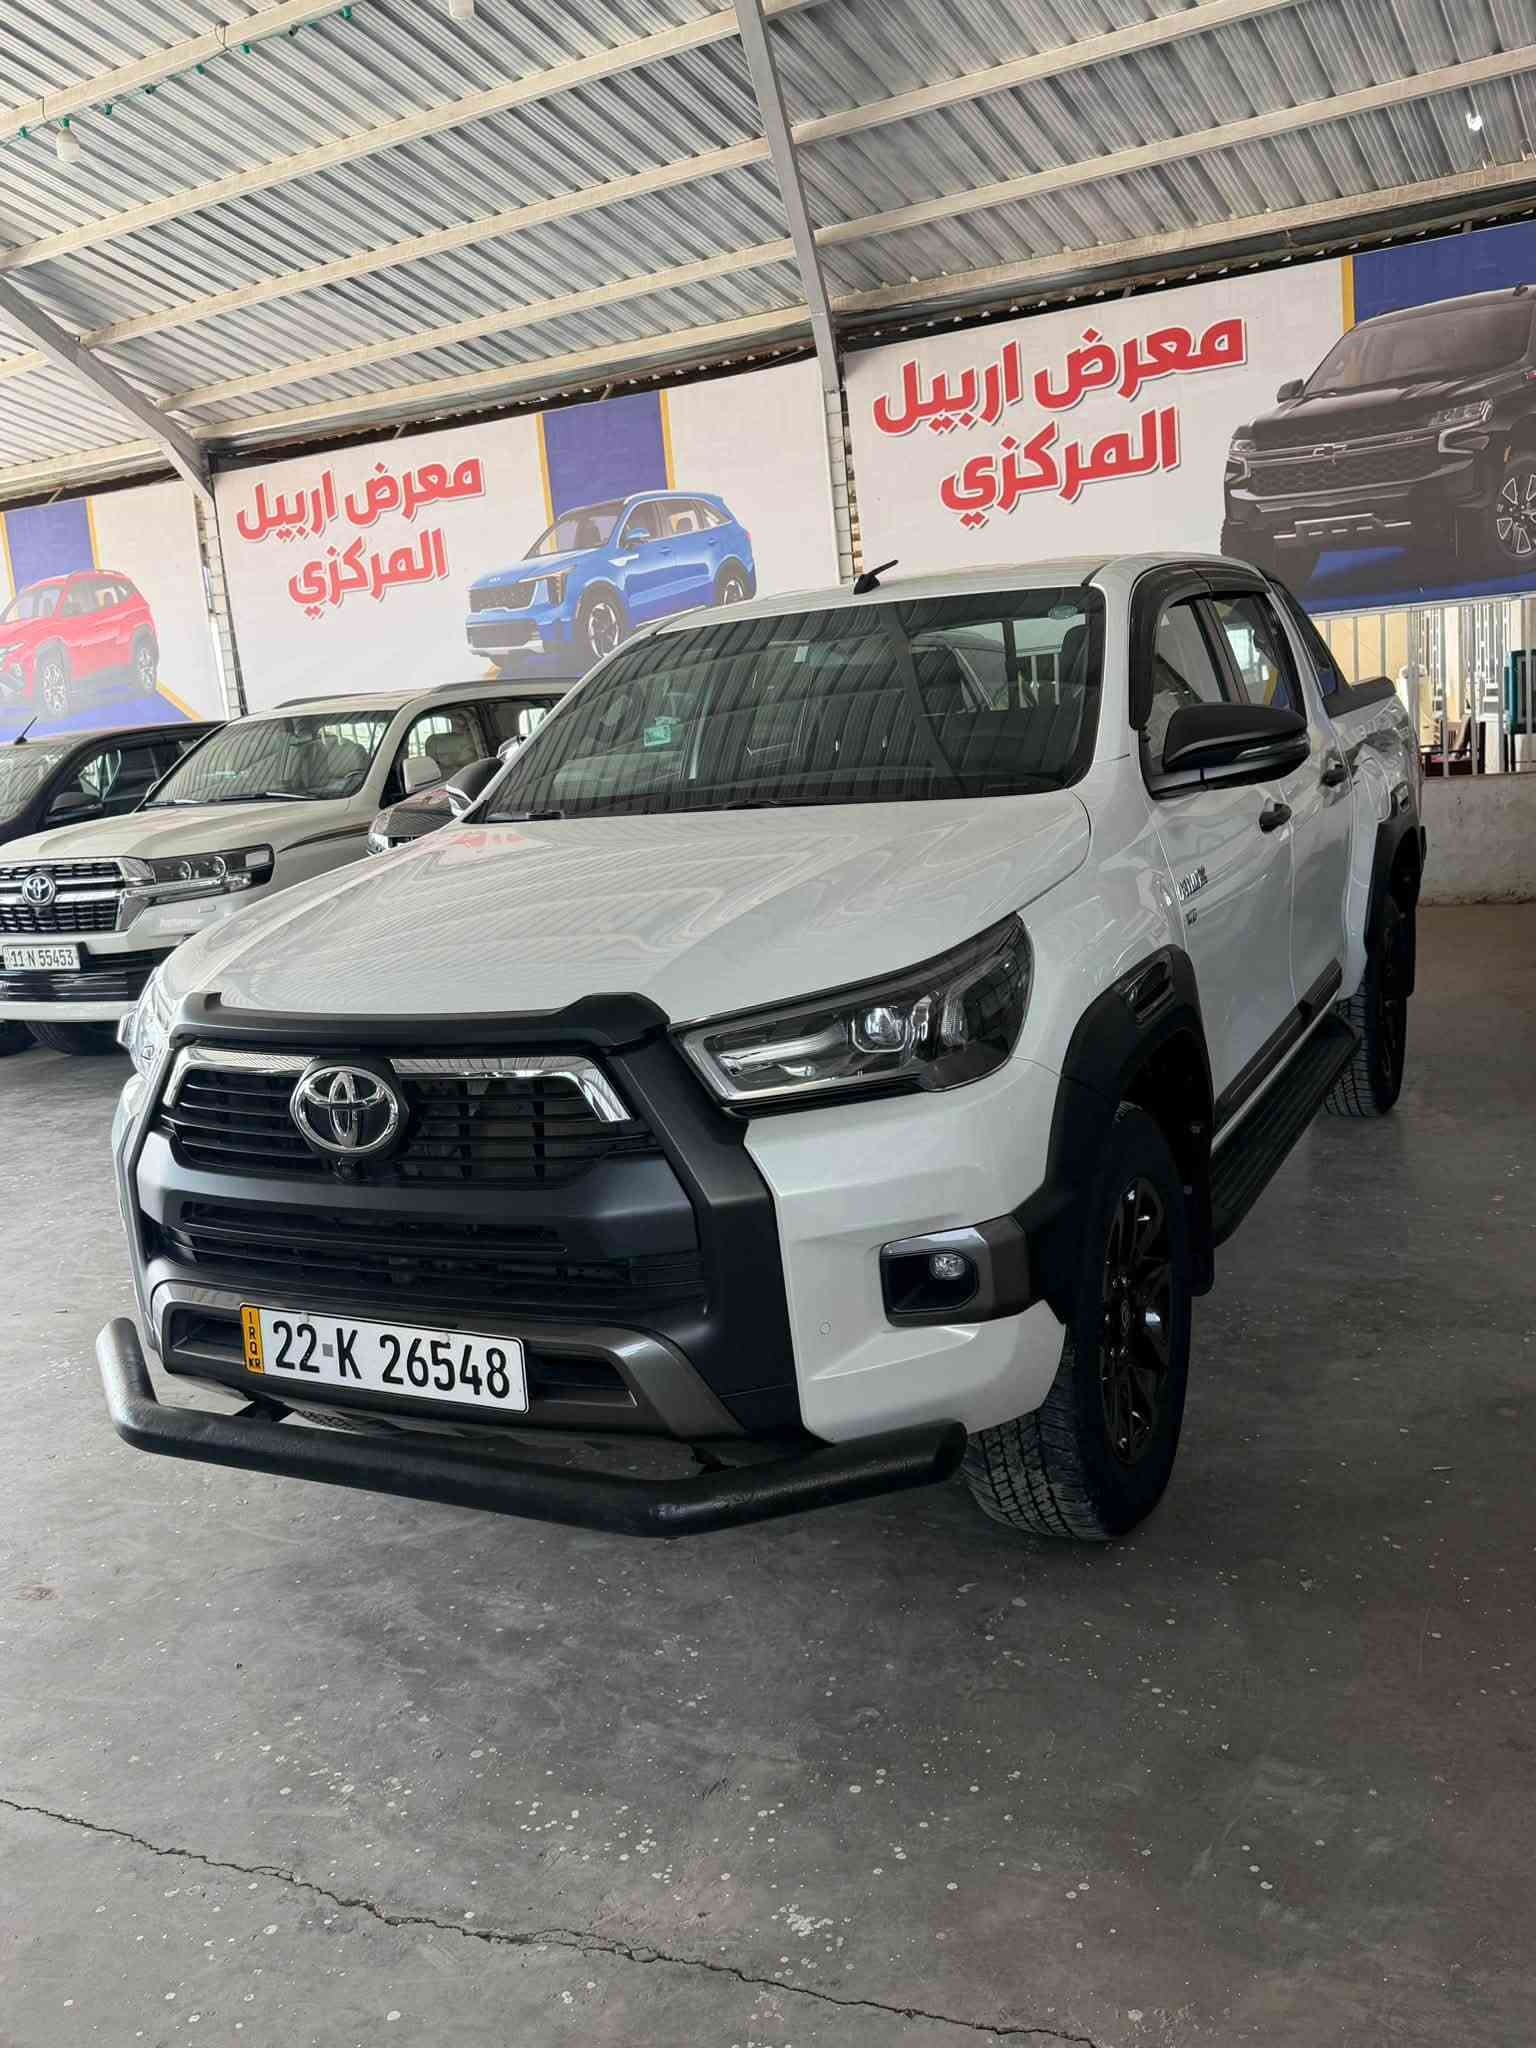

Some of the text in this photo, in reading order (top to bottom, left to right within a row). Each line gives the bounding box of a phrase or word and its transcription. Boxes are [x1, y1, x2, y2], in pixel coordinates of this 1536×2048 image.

[871, 318, 1247, 436] معرض اربيل
[235, 457, 484, 543] معرض اربيل
[938, 405, 1179, 529] المركزي
[287, 526, 448, 619] المركزي
[11, 949, 74, 967] 11 N 55453
[247, 1311, 258, 1355] IRQ
[379, 1334, 510, 1399] 26548
